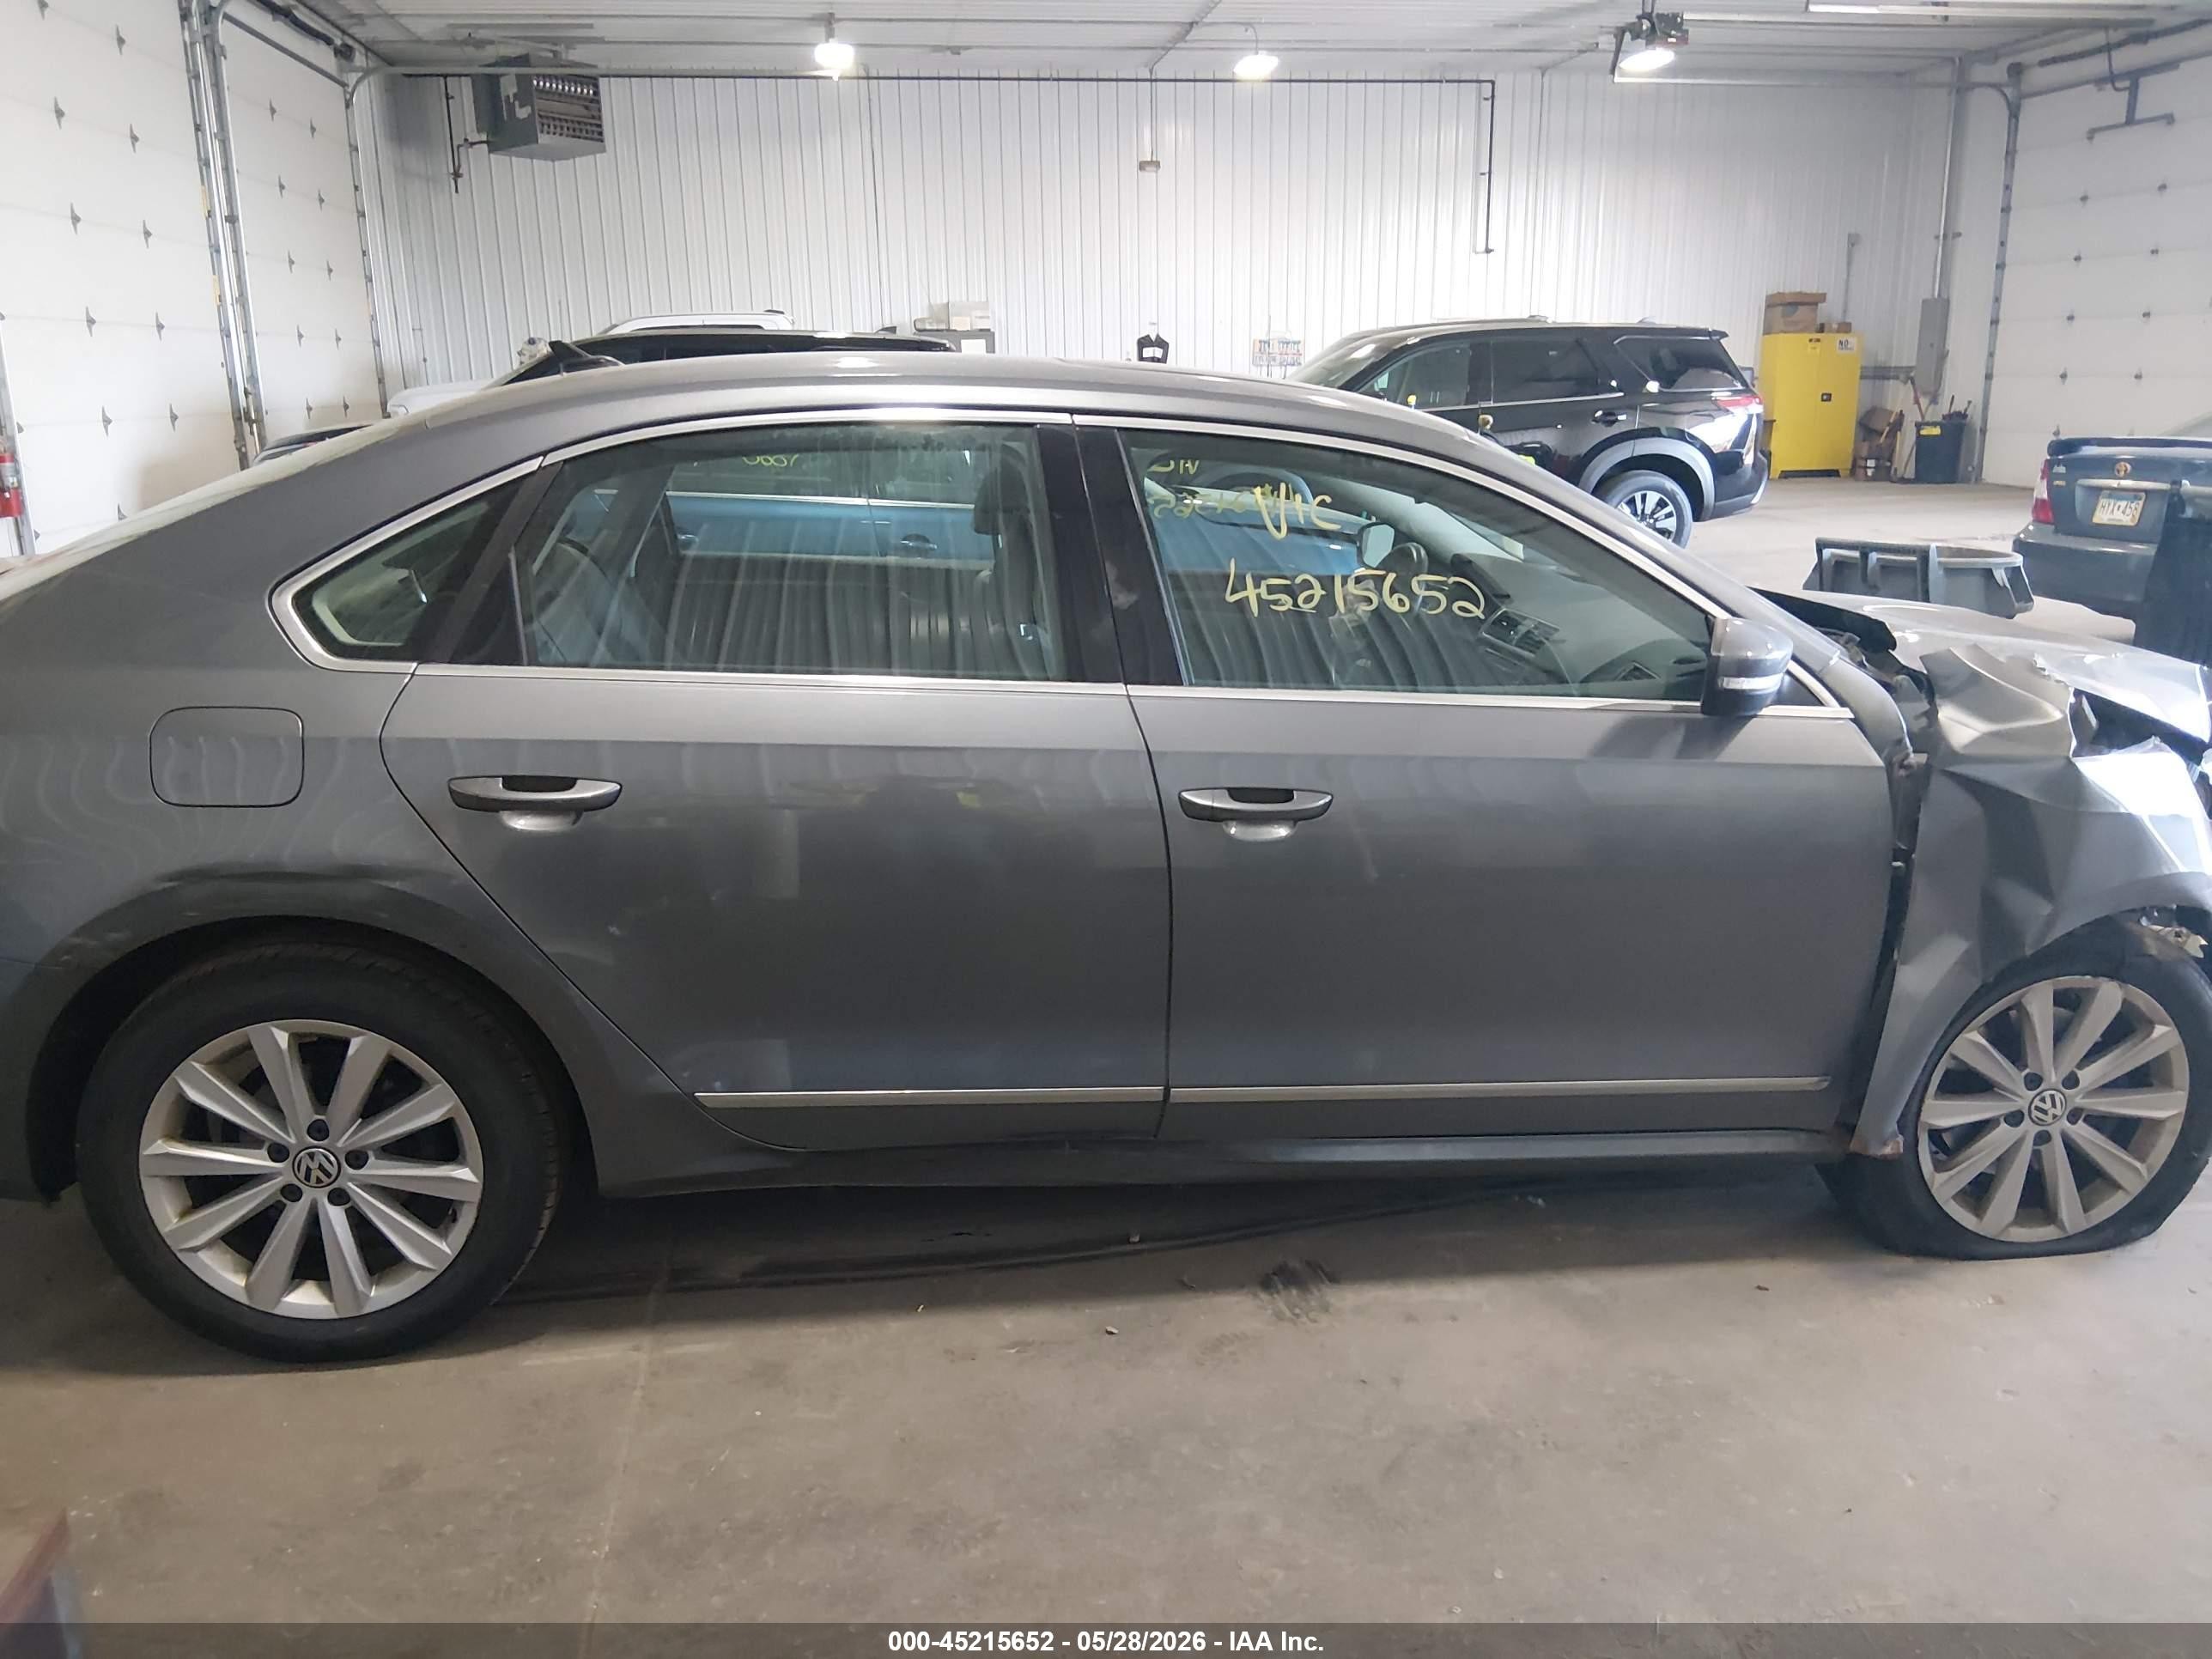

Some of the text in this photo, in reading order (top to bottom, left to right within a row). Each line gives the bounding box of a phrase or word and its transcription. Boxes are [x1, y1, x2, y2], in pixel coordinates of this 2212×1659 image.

[1224, 557, 1486, 619] 45215652
[2029, 1090, 2067, 1126] VW
[294, 1147, 340, 1188] VW
